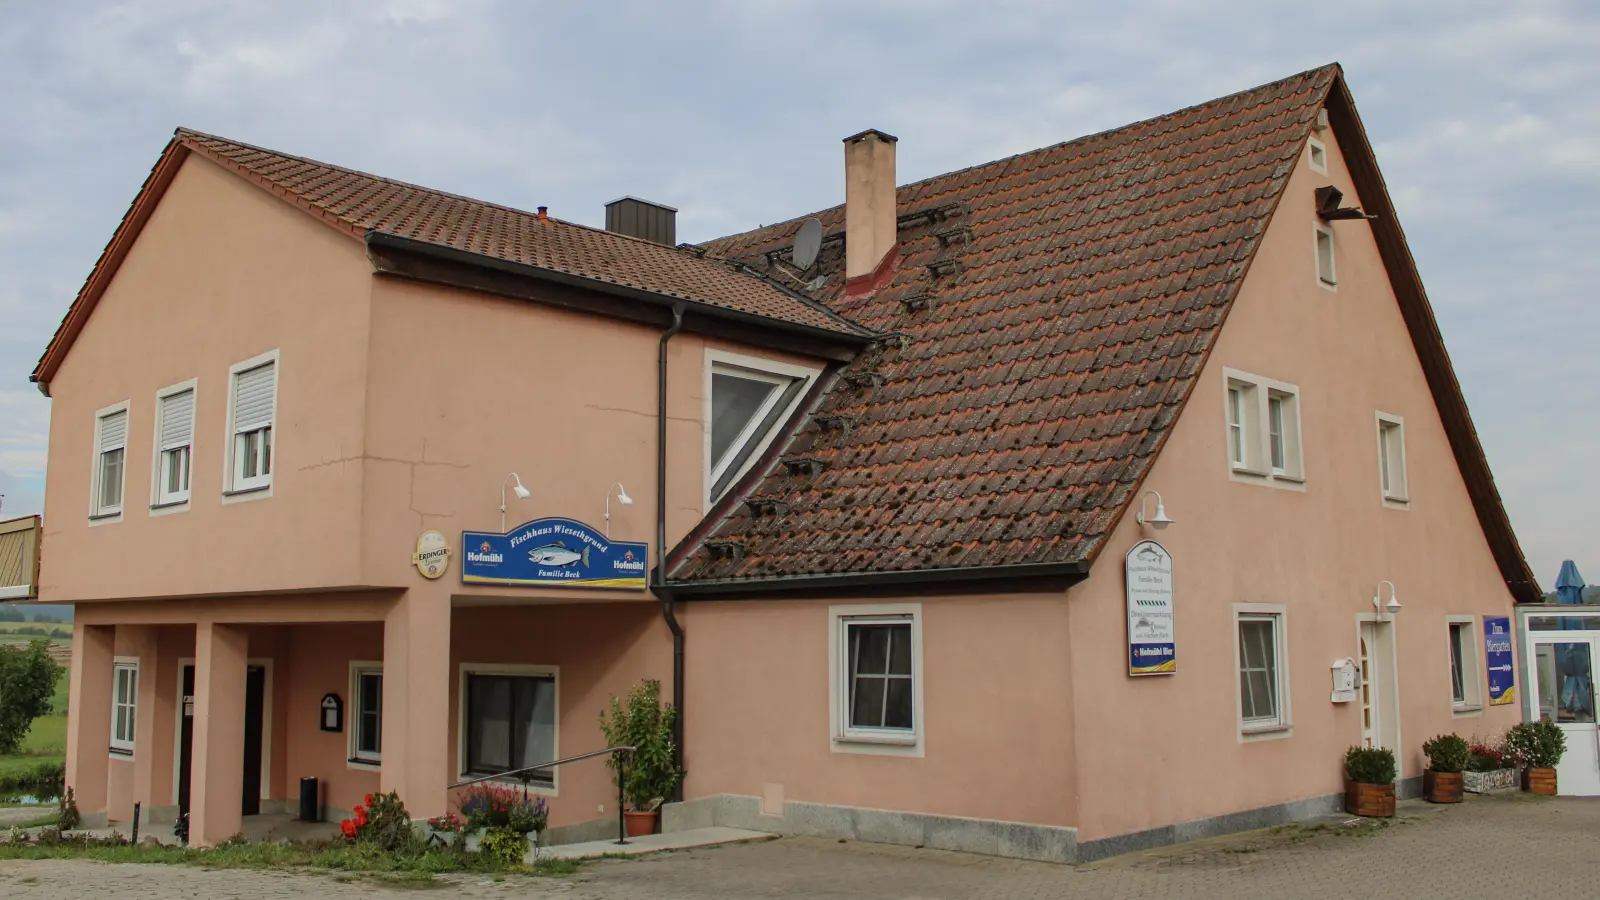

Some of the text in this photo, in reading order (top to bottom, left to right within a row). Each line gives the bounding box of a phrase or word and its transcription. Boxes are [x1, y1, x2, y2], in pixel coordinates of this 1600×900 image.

[510, 524, 608, 553] Fischhaus Wiesethgrund
[419, 548, 448, 560] ERDINGER
[467, 551, 503, 563] Hofmühl
[613, 560, 644, 571] Hofmühl
[538, 569, 580, 578] Familie Beck
[1492, 622, 1504, 635] Zum
[1139, 647, 1163, 656] Hofmühl
[1486, 640, 1511, 656] Biergarten
